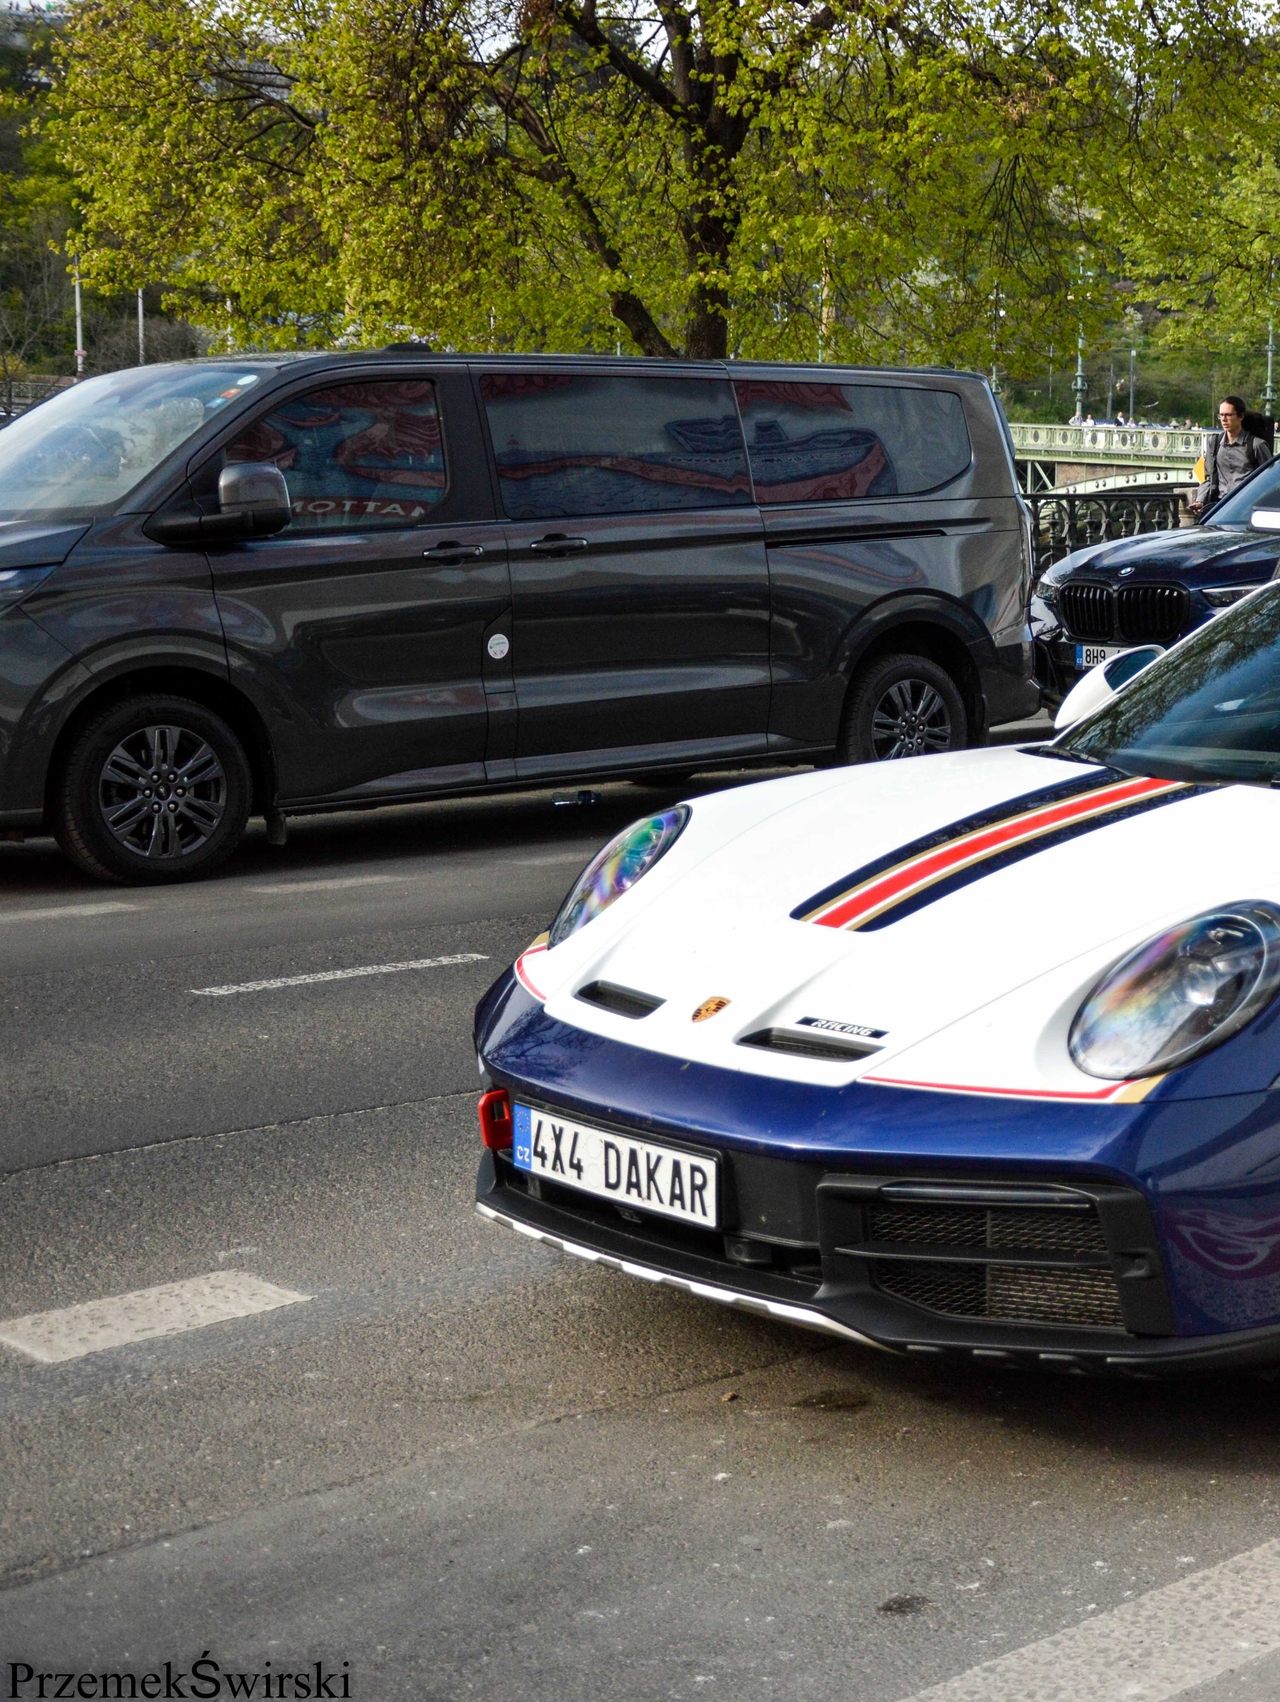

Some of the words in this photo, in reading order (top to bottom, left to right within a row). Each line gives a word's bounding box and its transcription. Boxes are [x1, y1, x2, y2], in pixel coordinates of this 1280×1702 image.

[811, 1019, 875, 1036] RACING
[516, 1145, 530, 1162] CZ
[533, 1119, 584, 1180] 4X4
[603, 1140, 708, 1217] DAKAR
